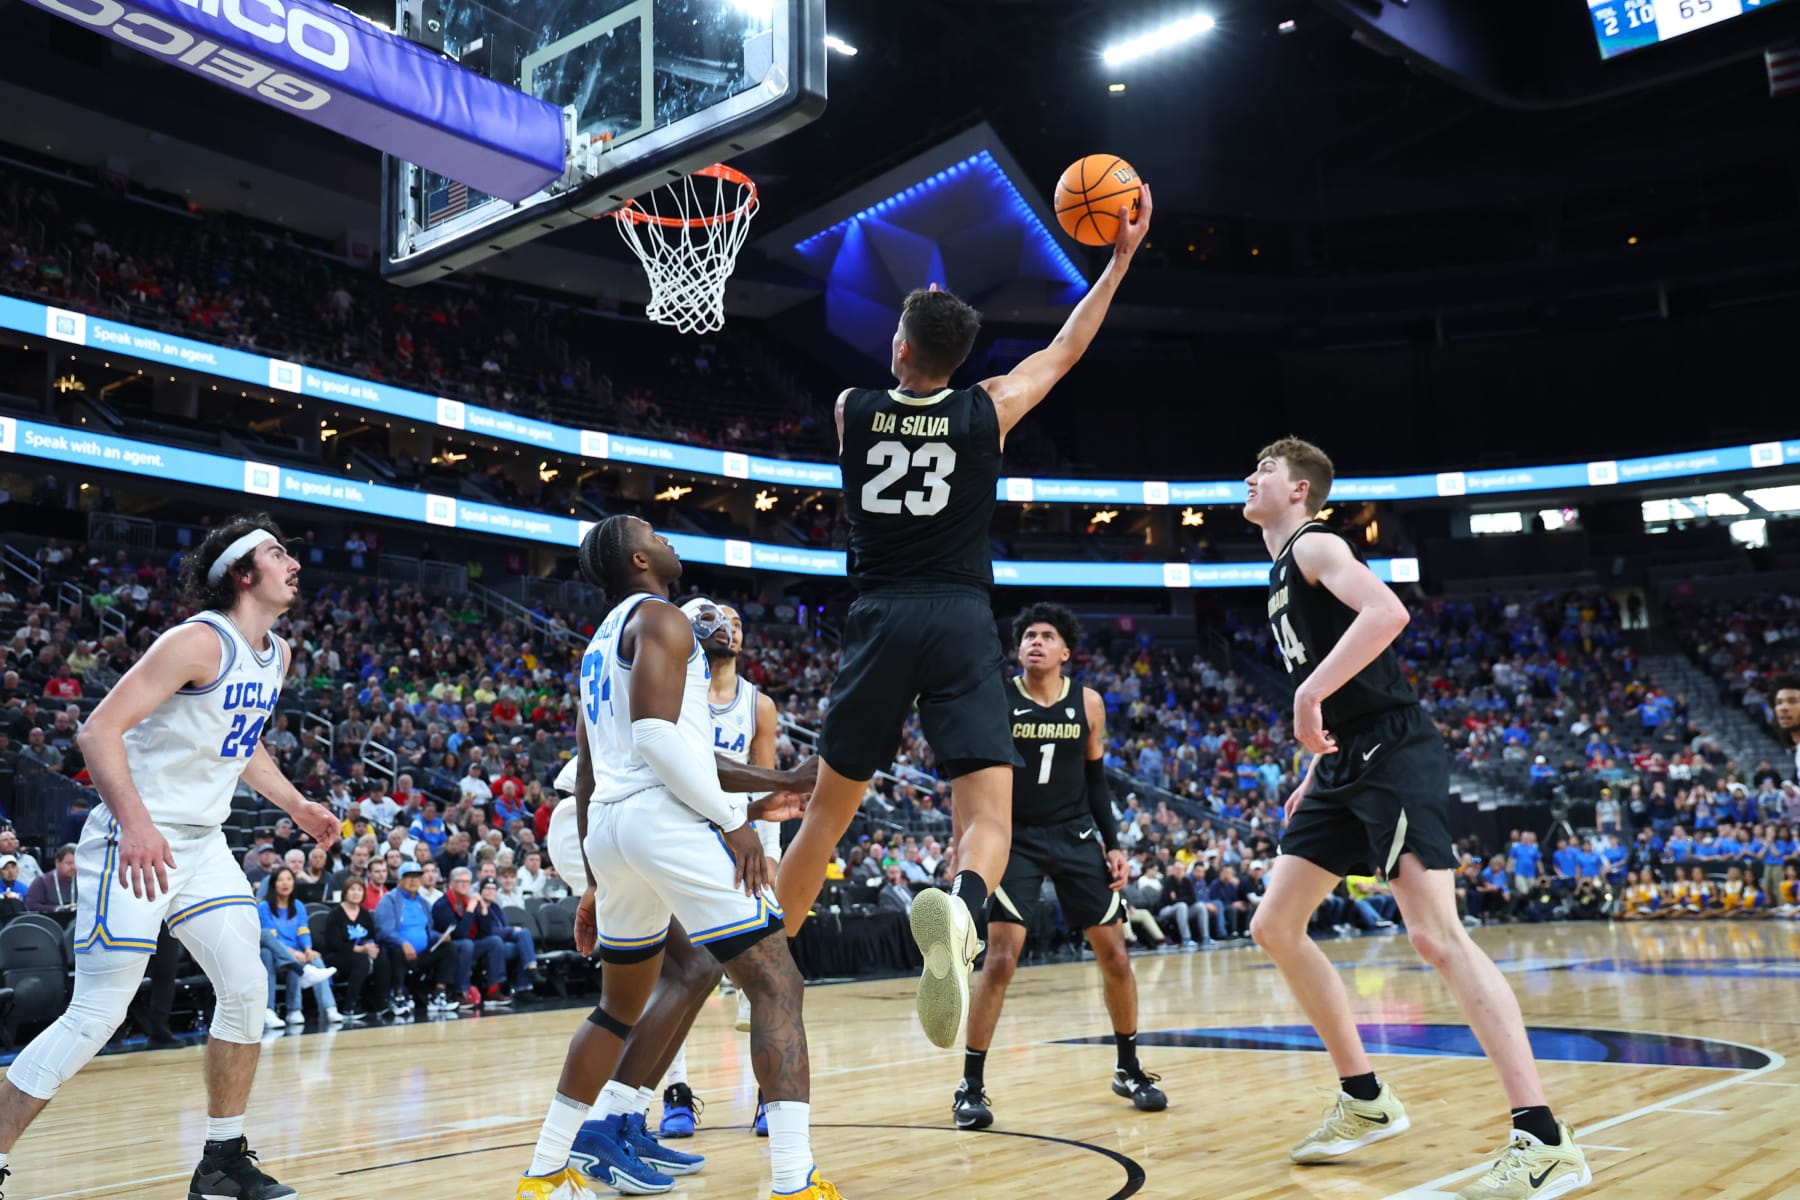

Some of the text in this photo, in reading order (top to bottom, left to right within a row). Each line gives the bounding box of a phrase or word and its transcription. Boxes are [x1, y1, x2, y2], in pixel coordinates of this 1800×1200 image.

[1603, 16, 1620, 37] 2
[1626, 4, 1656, 29] 10
[93, 325, 132, 345] Speak
[133, 336, 160, 352] with
[162, 344, 178, 356] an
[180, 348, 217, 365] agent.
[871, 411, 949, 437] DA SILVA
[24, 430, 165, 468] Speak with an agent.
[861, 440, 957, 516] 23
[223, 682, 278, 712] UCLA
[220, 714, 265, 757] 24
[714, 727, 745, 752] LA
[1012, 723, 1081, 739] COLORADO
[1038, 743, 1056, 785] 1
